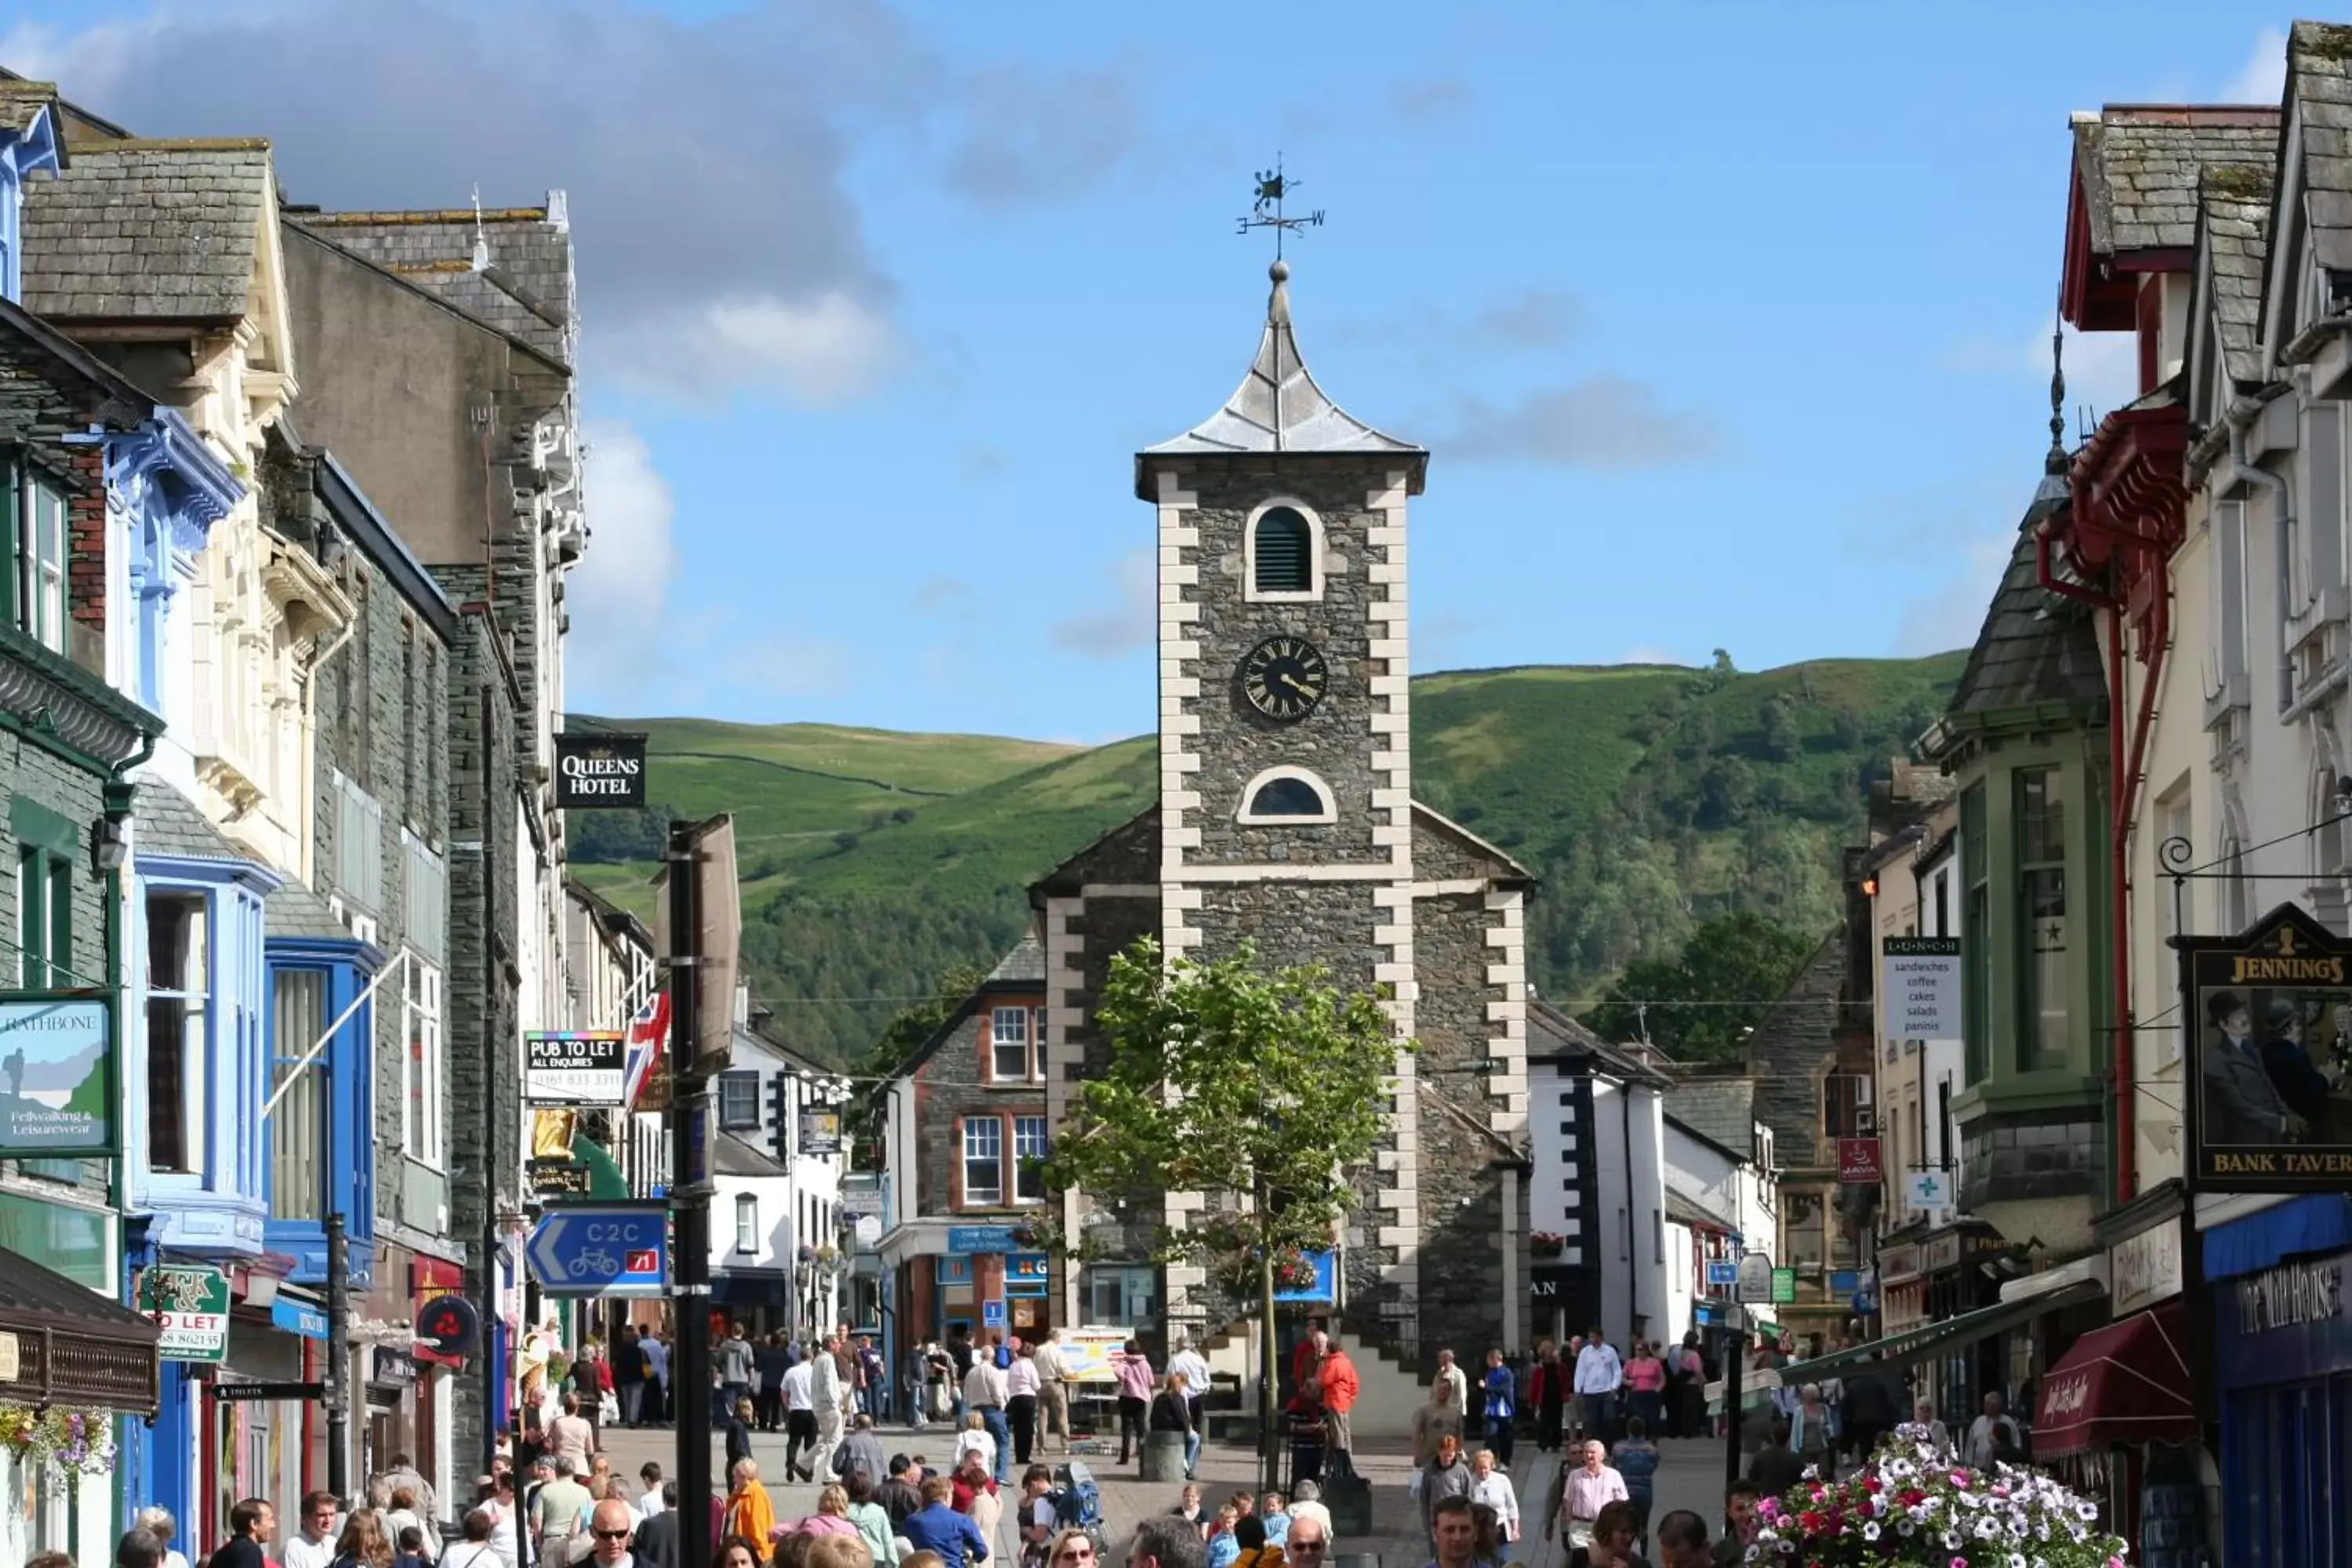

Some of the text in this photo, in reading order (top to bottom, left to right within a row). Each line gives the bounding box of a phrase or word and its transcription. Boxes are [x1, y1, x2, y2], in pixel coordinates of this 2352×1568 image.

[562, 755, 640, 779] QUEENS
[571, 778, 632, 795] HOTEL
[1895, 961, 1950, 973] sandwiches
[2231, 956, 2344, 984] JENNINGS
[1907, 976, 1938, 987] coffee
[1908, 992, 1936, 1001] cakes
[1906, 1006, 1937, 1017] salads
[4, 1015, 97, 1032] RATHBONE
[1904, 1022, 1940, 1033] paninis
[530, 1040, 615, 1057] PUB TO LET
[532, 1058, 593, 1069] ALL ENQUIRIES
[11, 1109, 82, 1123] Fellwalking
[13, 1123, 90, 1135] Leisurewear
[1842, 1166, 1878, 1174] JAVA
[2213, 1153, 2276, 1173] BANK
[632, 1254, 651, 1269] 71
[2290, 1261, 2336, 1326] House
[183, 1315, 220, 1330] LET
